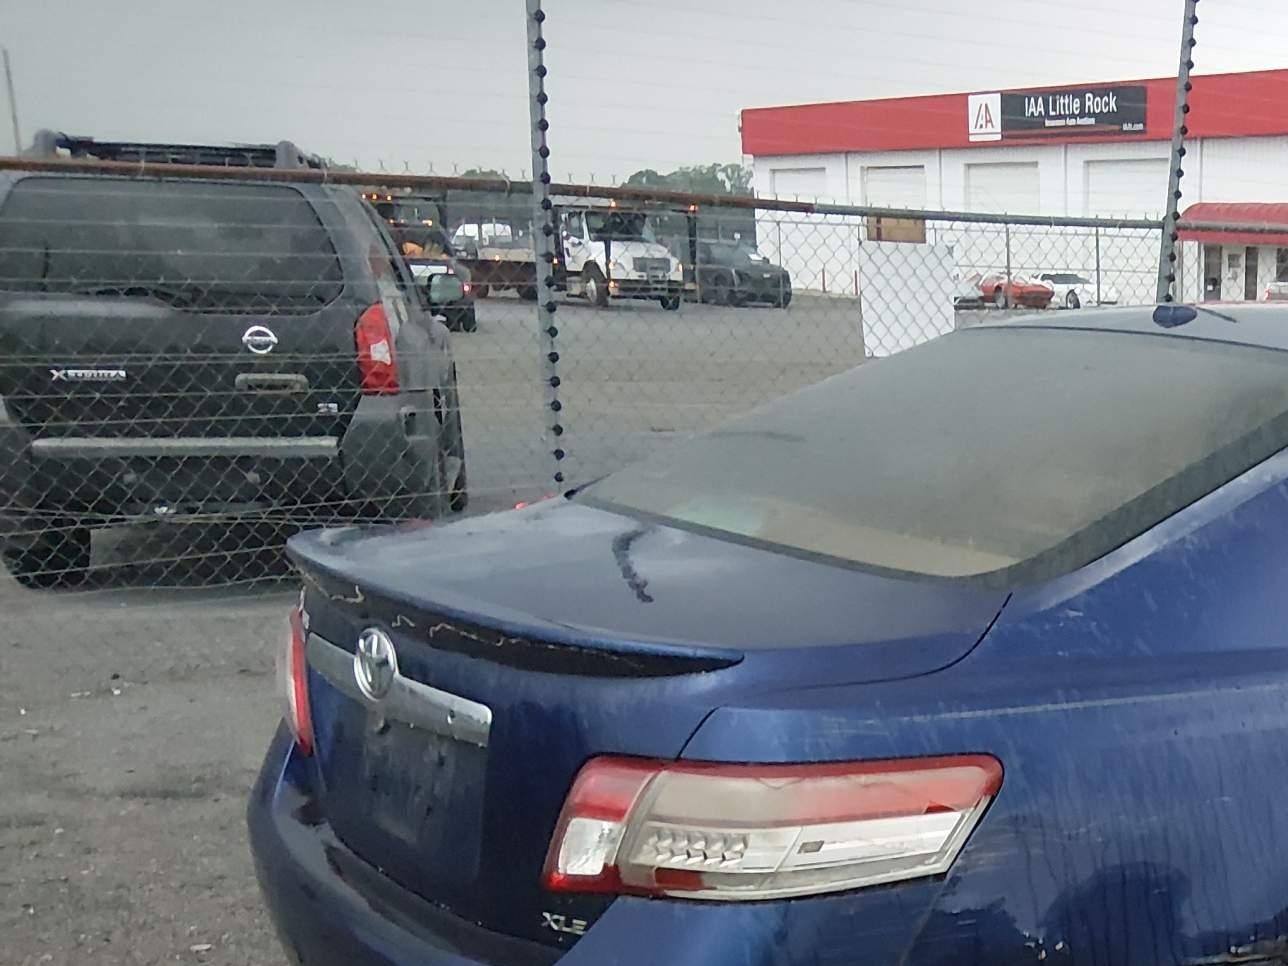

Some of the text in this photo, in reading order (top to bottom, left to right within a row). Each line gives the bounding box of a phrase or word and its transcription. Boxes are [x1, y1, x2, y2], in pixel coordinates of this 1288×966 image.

[1024, 91, 1117, 117] IAA Little Rock
[541, 911, 587, 935] XLE
